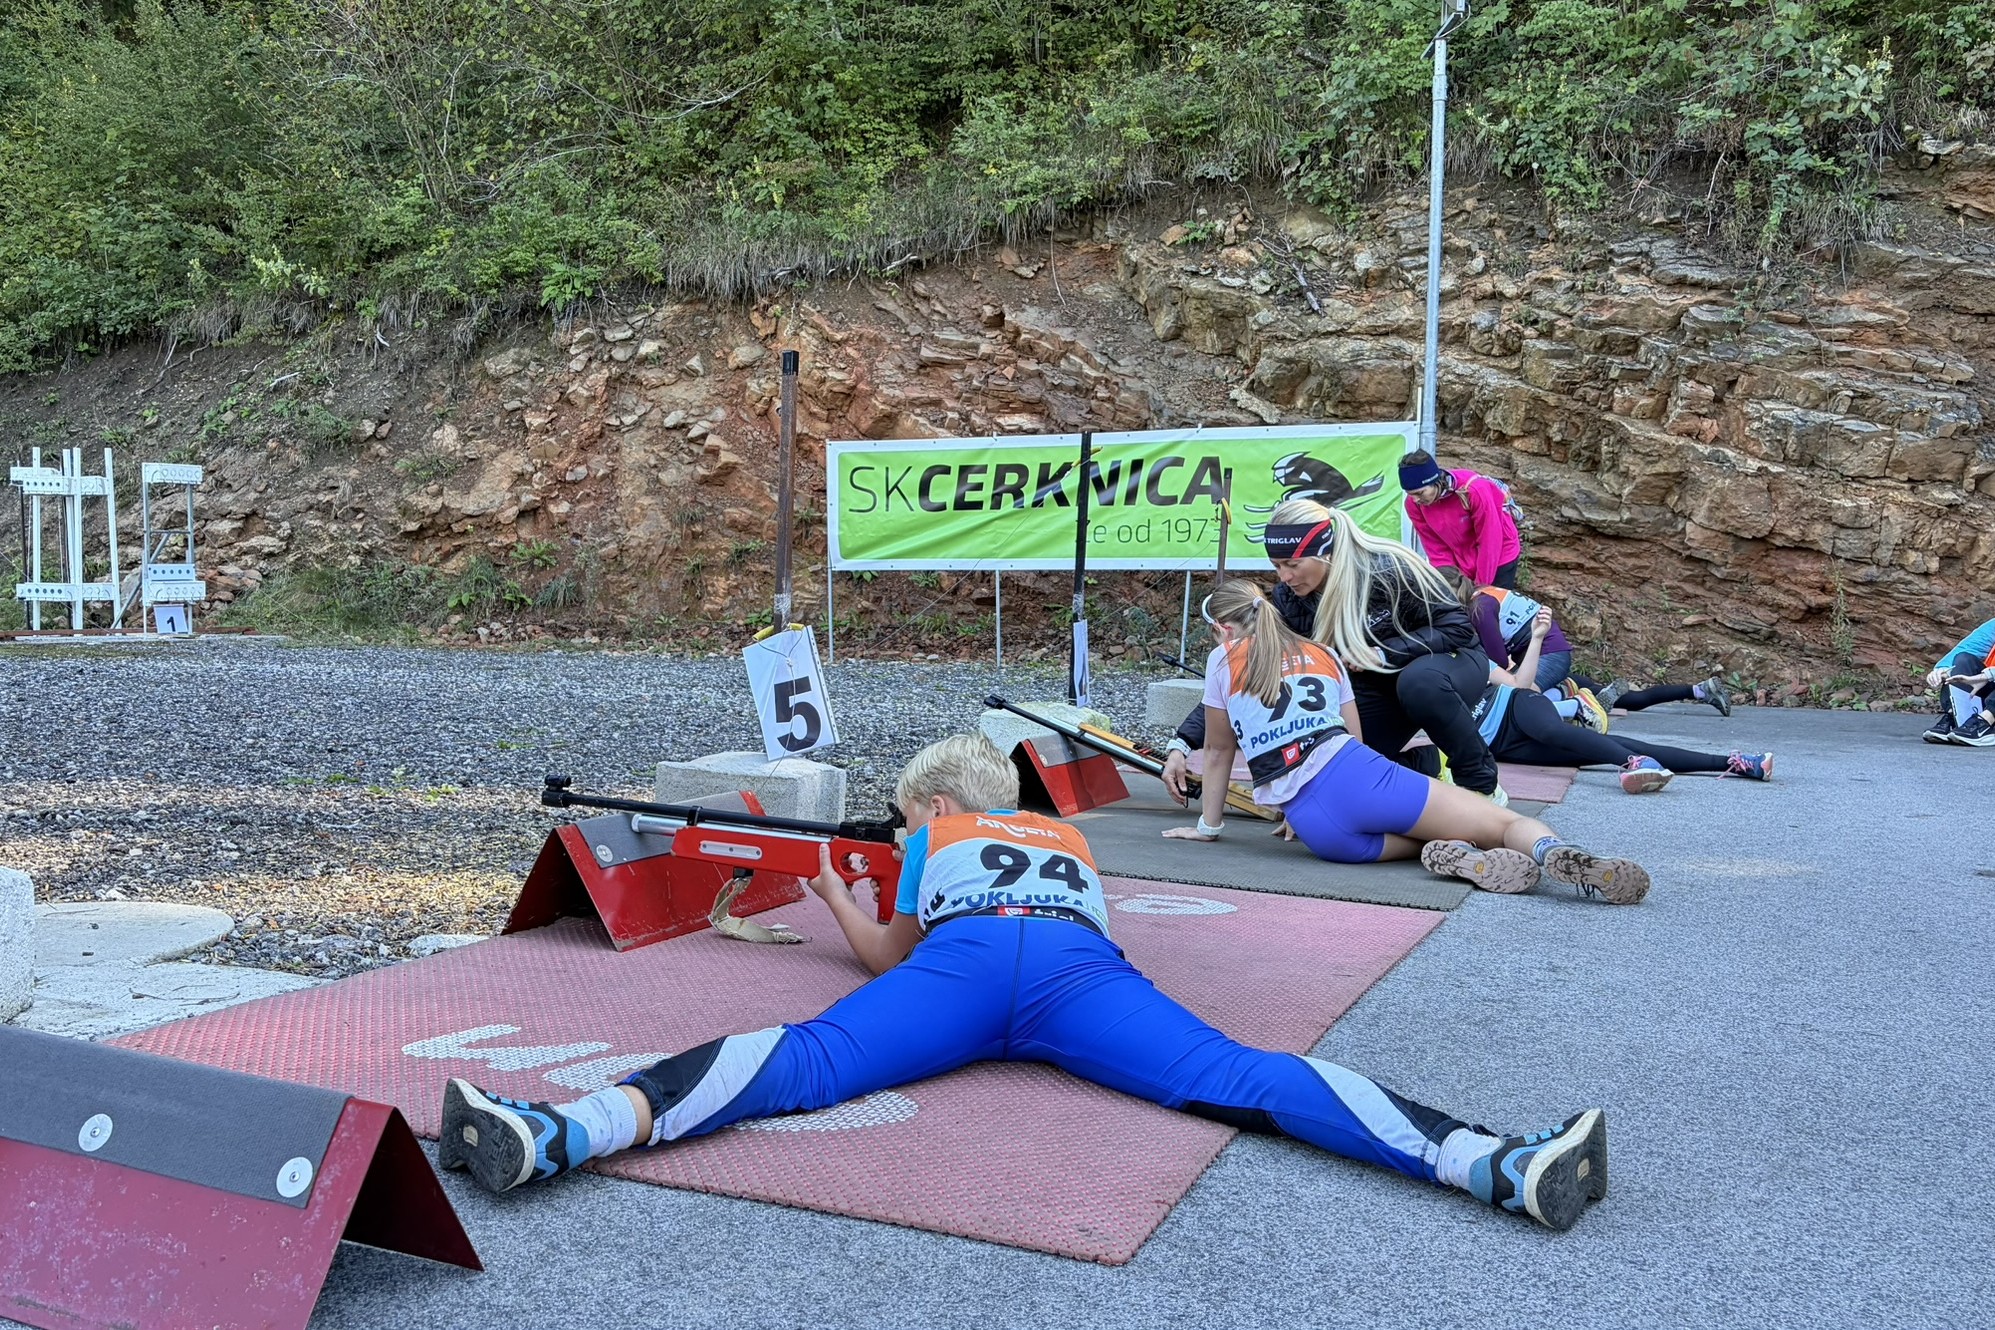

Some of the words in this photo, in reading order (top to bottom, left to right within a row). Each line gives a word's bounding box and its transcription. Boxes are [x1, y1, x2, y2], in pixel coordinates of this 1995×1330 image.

[1117, 518, 1150, 543] od
[166, 616, 176, 632] 1
[774, 675, 821, 752] 5
[1260, 676, 1327, 723] 93
[1472, 697, 1487, 720] riglav
[1250, 716, 1328, 749] POKLJUKA
[980, 843, 1090, 894] 94
